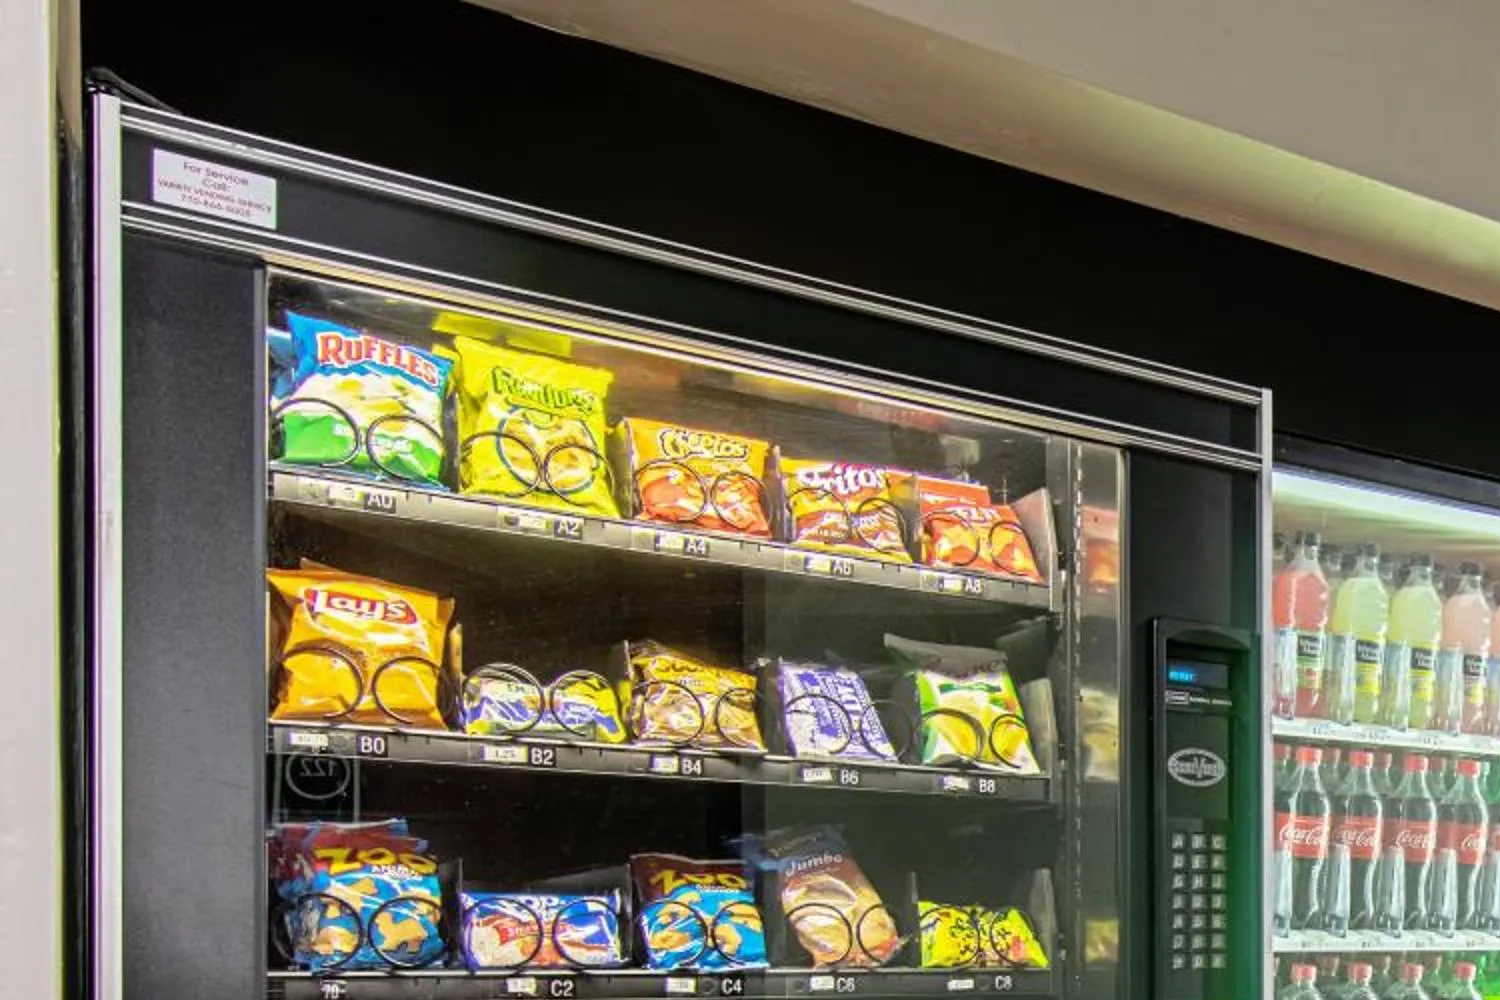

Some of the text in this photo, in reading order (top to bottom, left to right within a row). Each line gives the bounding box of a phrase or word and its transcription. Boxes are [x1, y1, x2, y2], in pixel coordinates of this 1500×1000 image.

[183, 161, 249, 186] For Service
[557, 519, 580, 536] A2
[686, 540, 706, 555] A4
[361, 737, 385, 754] B0
[531, 749, 554, 766] B2
[682, 759, 703, 775] B4
[840, 769, 859, 785] B6
[979, 779, 996, 793] B8
[551, 979, 574, 997] C2
[721, 978, 743, 994] C4
[994, 976, 1013, 991] C8
